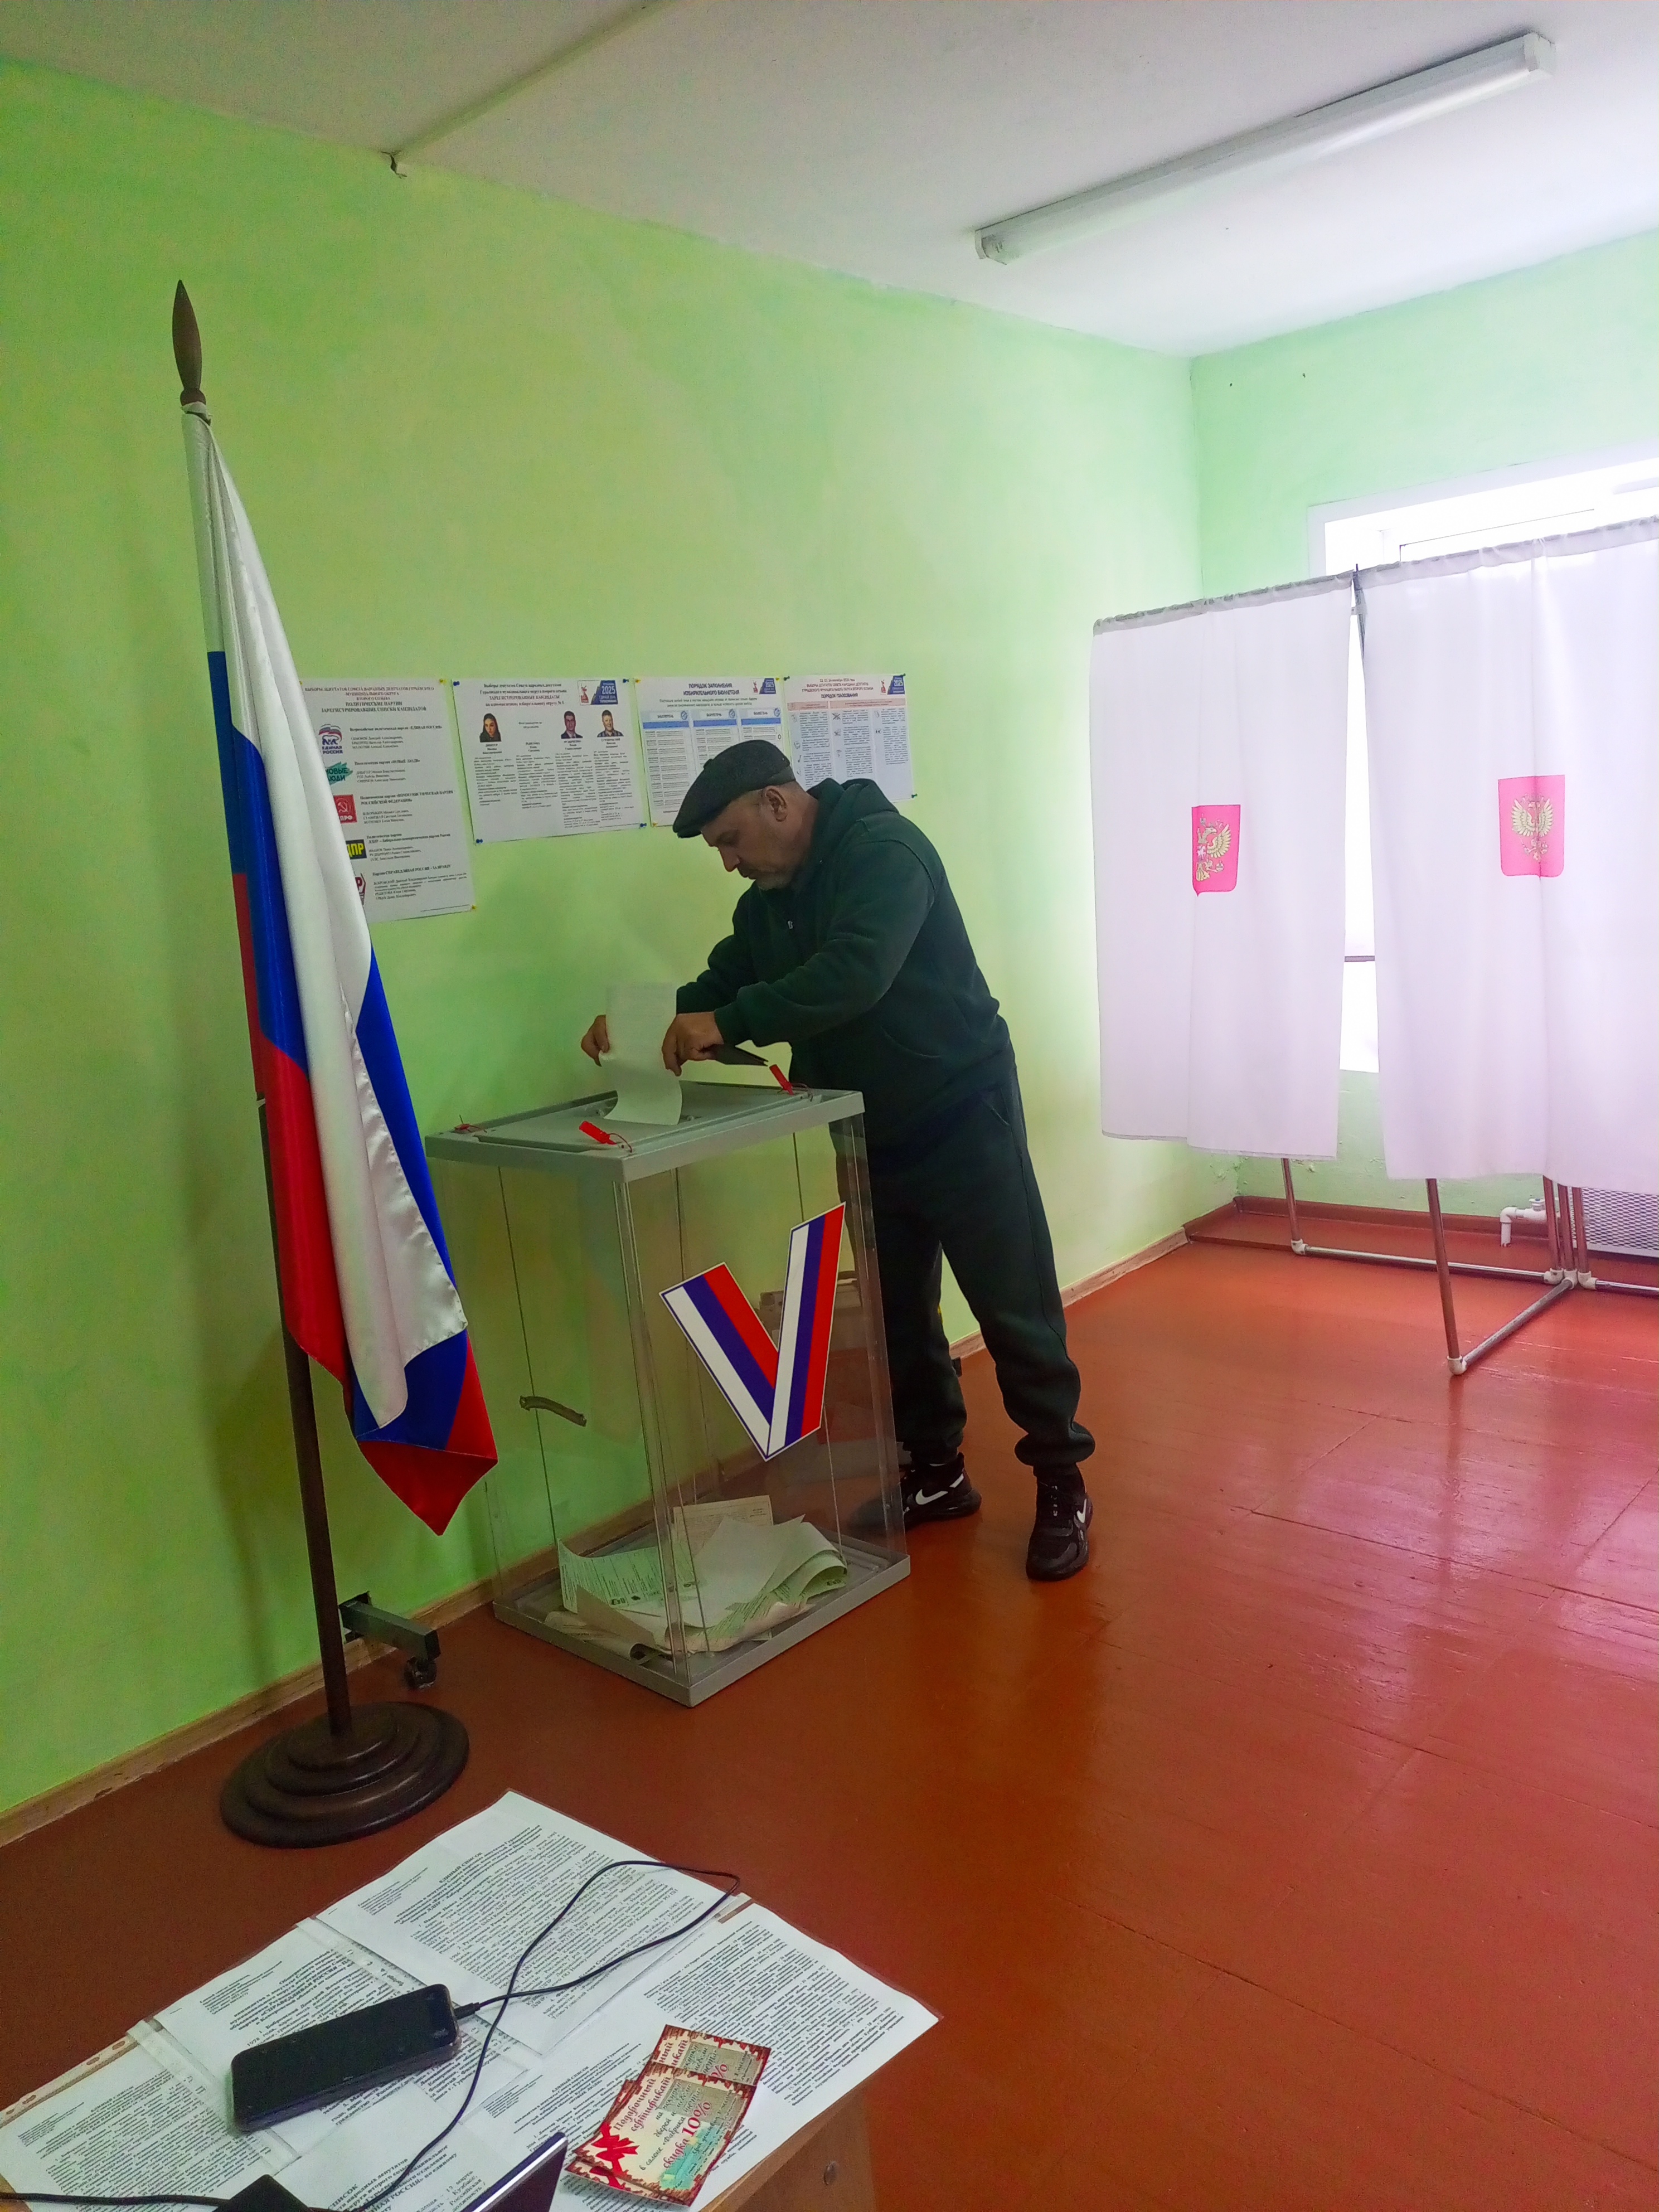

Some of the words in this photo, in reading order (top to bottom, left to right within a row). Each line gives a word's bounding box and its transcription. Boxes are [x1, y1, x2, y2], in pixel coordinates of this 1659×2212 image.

[601, 686, 615, 695] 2025
[347, 843, 364, 858] ДПР
[261, 1982, 312, 2016] «СПРАВЕДЛИВАЯ
[313, 1966, 338, 1983] РОССИЯ
[613, 2079, 656, 2130] Подарочный
[631, 2077, 671, 2131] сертификат
[653, 2118, 672, 2137] дверей
[646, 2147, 663, 2166] салоне
[662, 2117, 686, 2145] «Фабрика
[663, 2138, 690, 2169] скидка
[682, 2102, 711, 2136] 10%
[345, 2178, 377, 2203] народных
[377, 2158, 408, 2179] депутатов
[390, 2174, 424, 2199] РОССИЯ»
